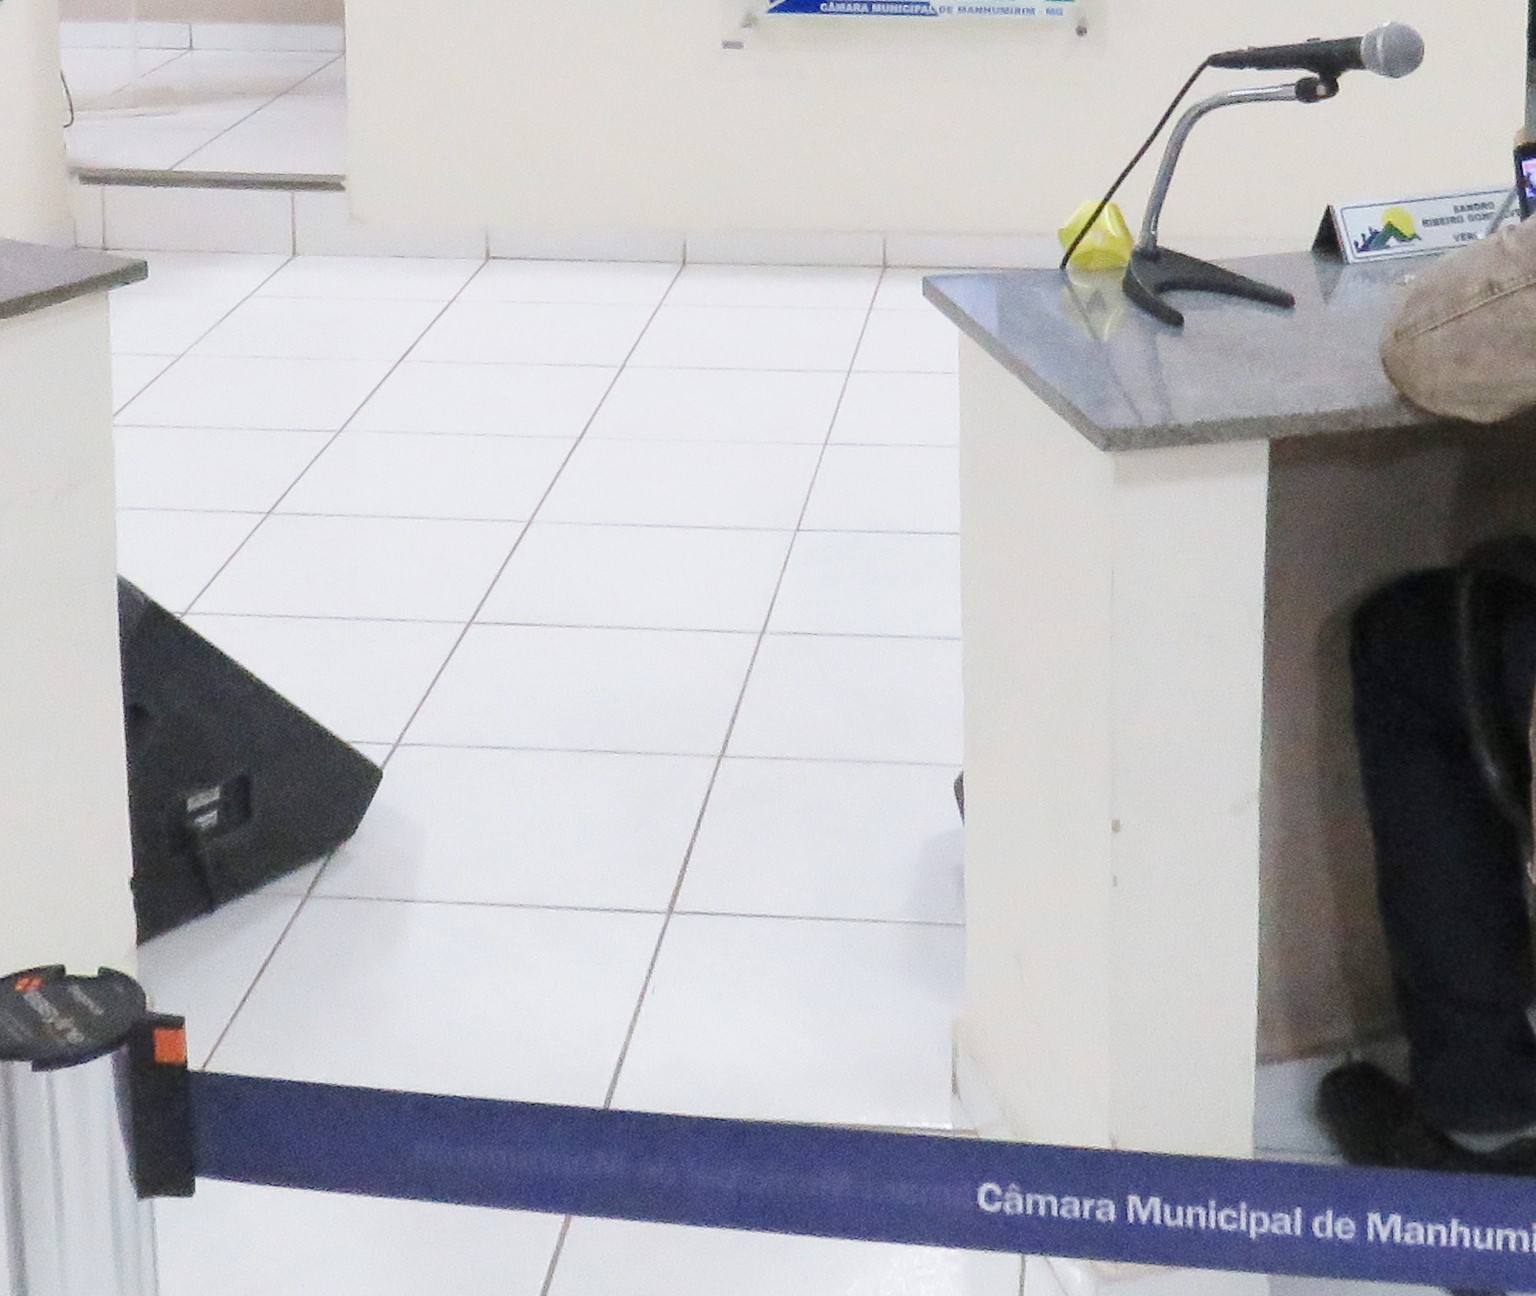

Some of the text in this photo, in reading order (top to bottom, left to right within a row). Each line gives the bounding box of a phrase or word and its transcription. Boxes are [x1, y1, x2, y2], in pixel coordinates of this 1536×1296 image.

[820, 1, 869, 15] CÂMARA
[872, 3, 937, 15] MUNICIPAL
[939, 6, 953, 14] DE
[976, 1180, 1117, 1225] Câmara
[1125, 1193, 1303, 1239] Municipal
[1311, 1210, 1357, 1241] de
